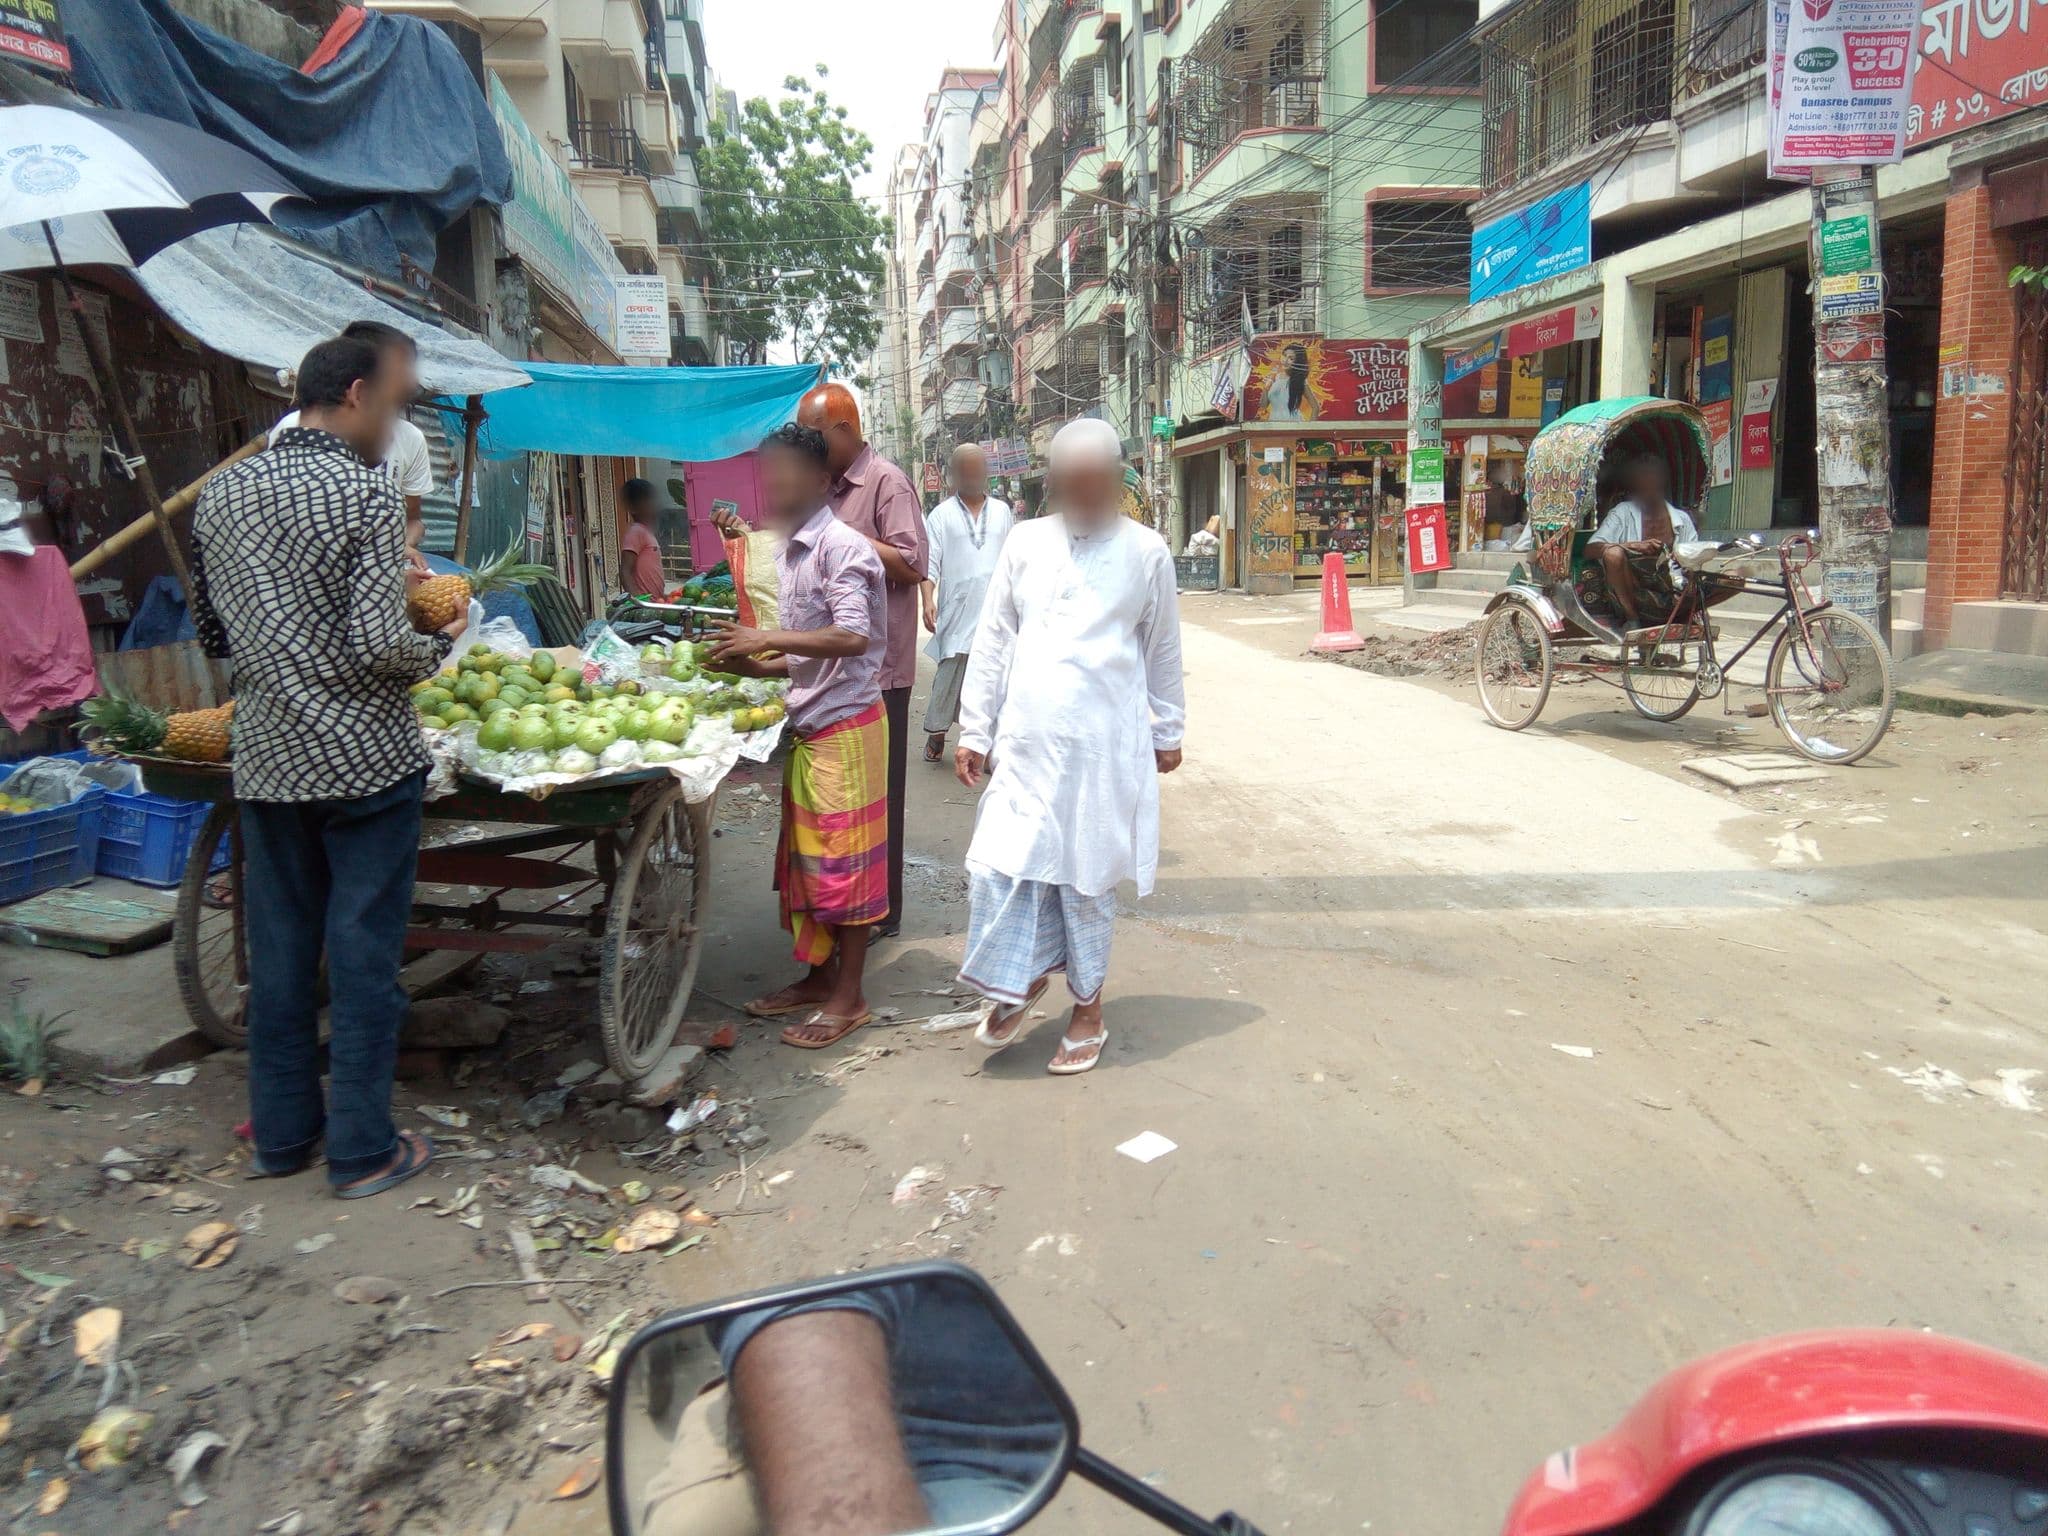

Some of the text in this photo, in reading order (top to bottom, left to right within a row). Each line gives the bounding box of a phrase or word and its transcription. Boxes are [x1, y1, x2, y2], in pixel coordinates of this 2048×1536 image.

[1839, 1, 1915, 11] INTERNATIONAL
[1849, 36, 1908, 47] Celebrating
[1798, 53, 1815, 67] 50%
[1852, 47, 1904, 71] 30
[1792, 75, 1835, 84] Play group
[1855, 77, 1902, 87] SUCCESS
[1801, 97, 1892, 107] Banasree Campus
[1955, 92, 1990, 121] ১৩,
[1789, 112, 1803, 120] Hot
[1804, 111, 1822, 120] Line
[50, 144, 90, 161] পুলিশ
[1859, 276, 1877, 289] ELI
[1536, 327, 1558, 344] বিকাশ
